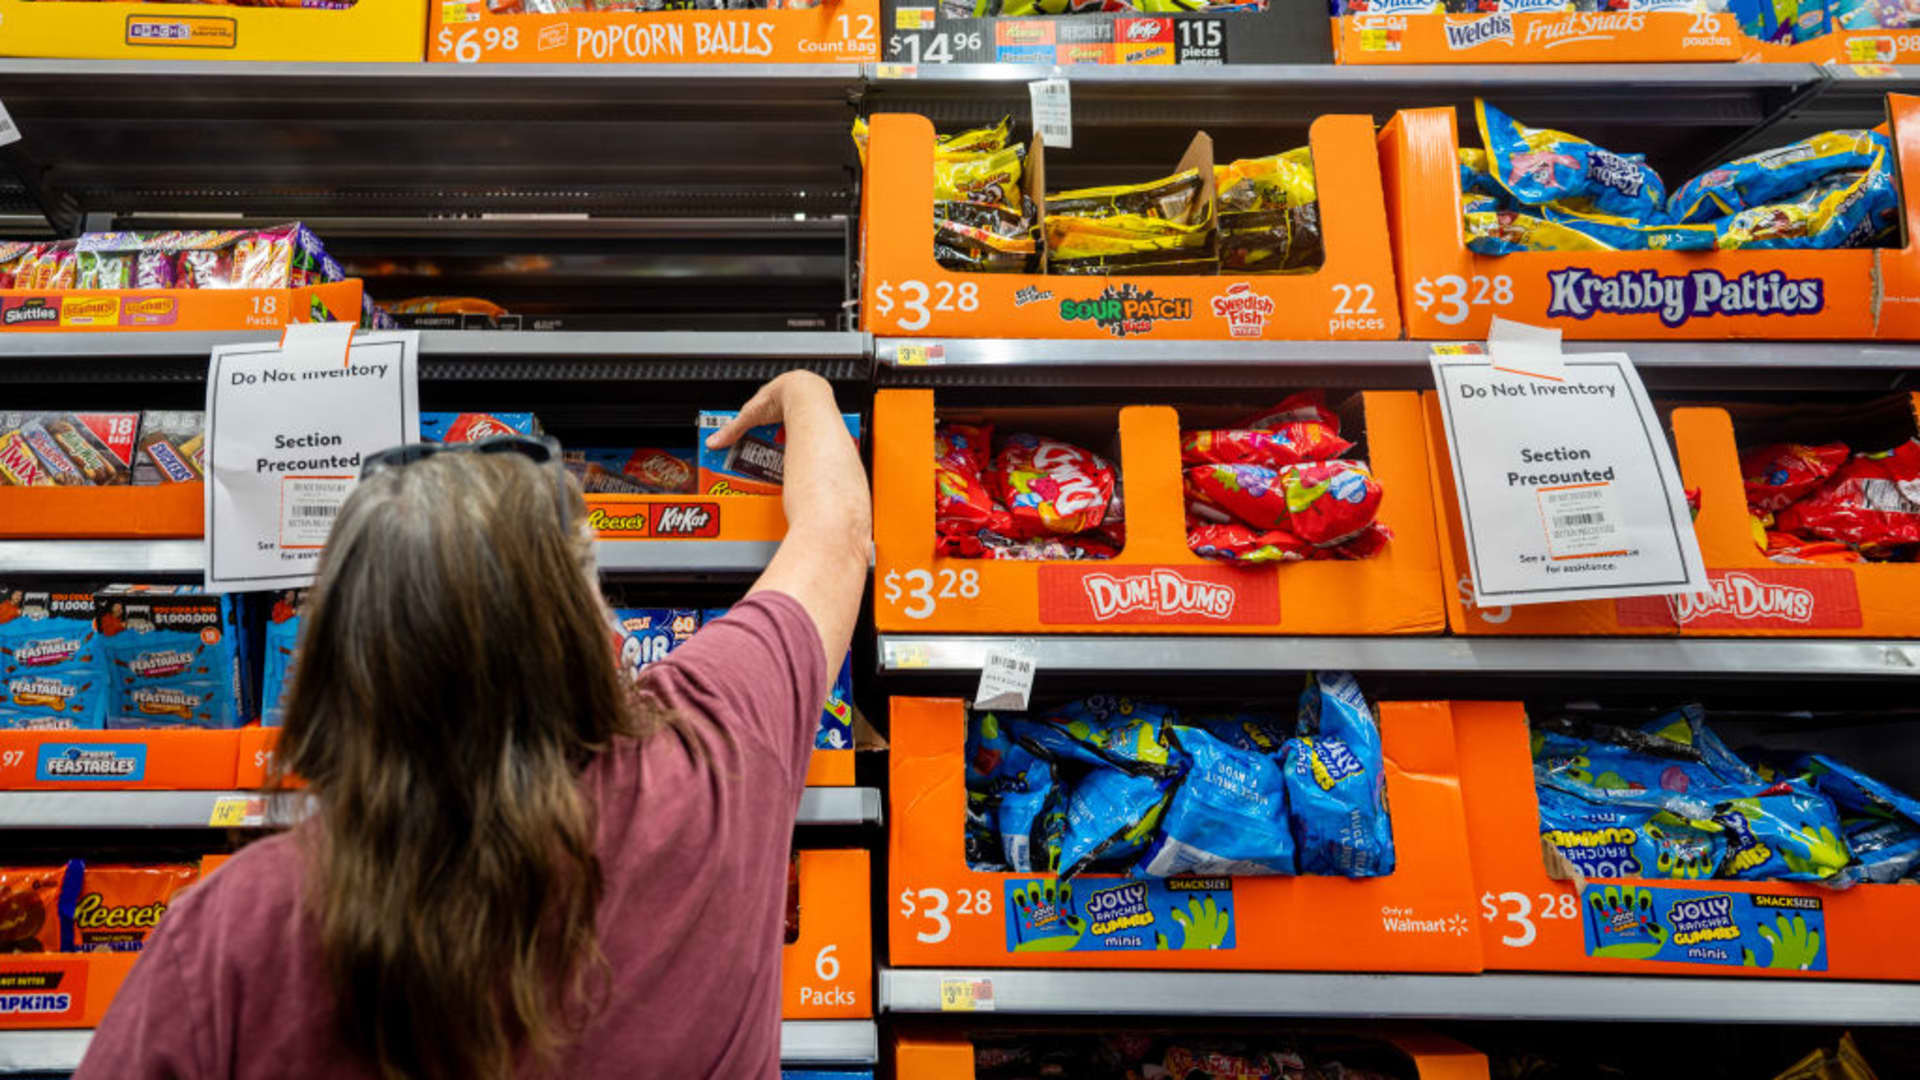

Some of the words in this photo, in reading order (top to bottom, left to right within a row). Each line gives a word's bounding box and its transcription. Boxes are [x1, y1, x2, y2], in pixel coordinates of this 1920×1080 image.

[837, 14, 875, 39] 12
[1179, 20, 1222, 46] 115
[1447, 15, 1512, 46] Welch's
[1525, 15, 1581, 44] Fruit
[1580, 11, 1646, 33] Snacks
[1687, 13, 1721, 34] 26
[576, 24, 684, 58] POPCORN
[694, 21, 775, 56] BALLS
[797, 39, 845, 52] Count
[847, 39, 877, 54] Bag
[1682, 34, 1732, 48] pouches
[1181, 47, 1220, 58] pieces
[251, 295, 277, 314] 18
[1213, 295, 1274, 316] Swedish
[1331, 284, 1377, 315] 22
[1550, 270, 1684, 323] Krabby
[1692, 270, 1820, 313] Patties
[5, 306, 56, 323] Skittles
[1060, 299, 1122, 320] SOUR
[1123, 298, 1192, 319] PATCH
[1230, 310, 1262, 326] Fish
[1328, 316, 1385, 333] pieces
[231, 372, 257, 386] Do
[1460, 383, 1487, 398] Do
[1492, 382, 1527, 397] Not
[1531, 382, 1616, 398] Inventory
[107, 418, 133, 435] 18
[275, 432, 342, 449] Section
[0, 433, 44, 486] TWIX
[256, 452, 361, 473] Precounted
[1520, 447, 1591, 463] Section
[1507, 466, 1615, 487] Precounted
[588, 509, 646, 530] Reese's
[672, 616, 696, 633] 60
[47, 758, 135, 775] FEASTABLES
[1089, 885, 1146, 913] JOLLY
[73, 893, 166, 927] Reese's
[1671, 897, 1729, 923] JOLLY
[1090, 911, 1155, 935] GUMMIES
[1382, 917, 1447, 933] Walmart
[1104, 935, 1142, 947] minis
[1673, 925, 1741, 945] GUMMIES
[815, 944, 841, 981] 6
[1687, 948, 1728, 960] minis
[799, 986, 856, 1006] Packs
